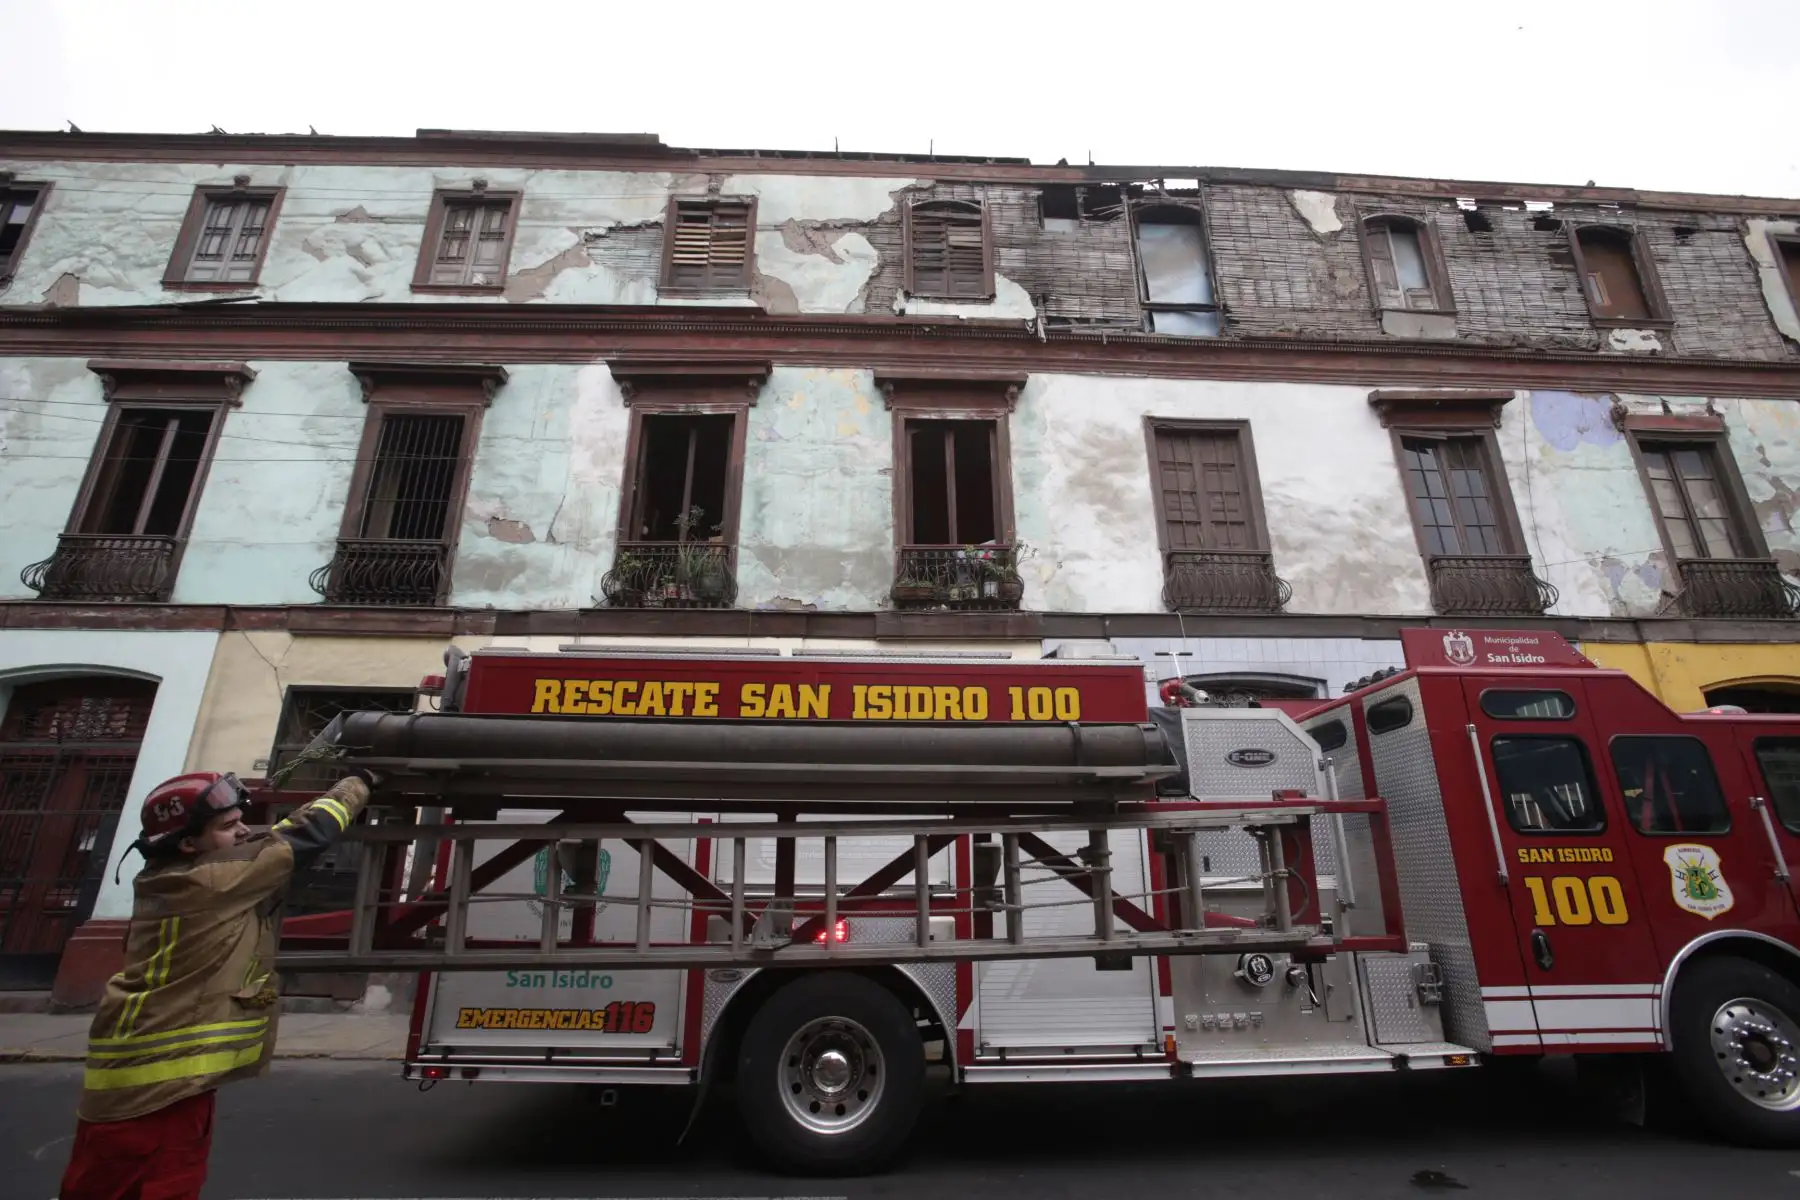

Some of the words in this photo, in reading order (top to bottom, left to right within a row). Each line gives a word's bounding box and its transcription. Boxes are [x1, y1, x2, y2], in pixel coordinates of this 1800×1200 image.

[1484, 636, 1539, 645] Municipalidad
[1487, 653, 1510, 663] San
[1513, 653, 1545, 663] Isidro
[531, 679, 720, 717] RESCATE
[740, 683, 831, 719] SAN
[852, 684, 988, 720] ISIDRO
[1009, 686, 1081, 721] 100
[1518, 848, 1555, 863] SAN
[1557, 848, 1613, 862] ISIDRO
[1524, 876, 1629, 926] 100
[506, 970, 546, 988] San
[552, 970, 613, 989] Isidro
[457, 1008, 605, 1030] EMERGENCIAS
[603, 1001, 655, 1033] 116
